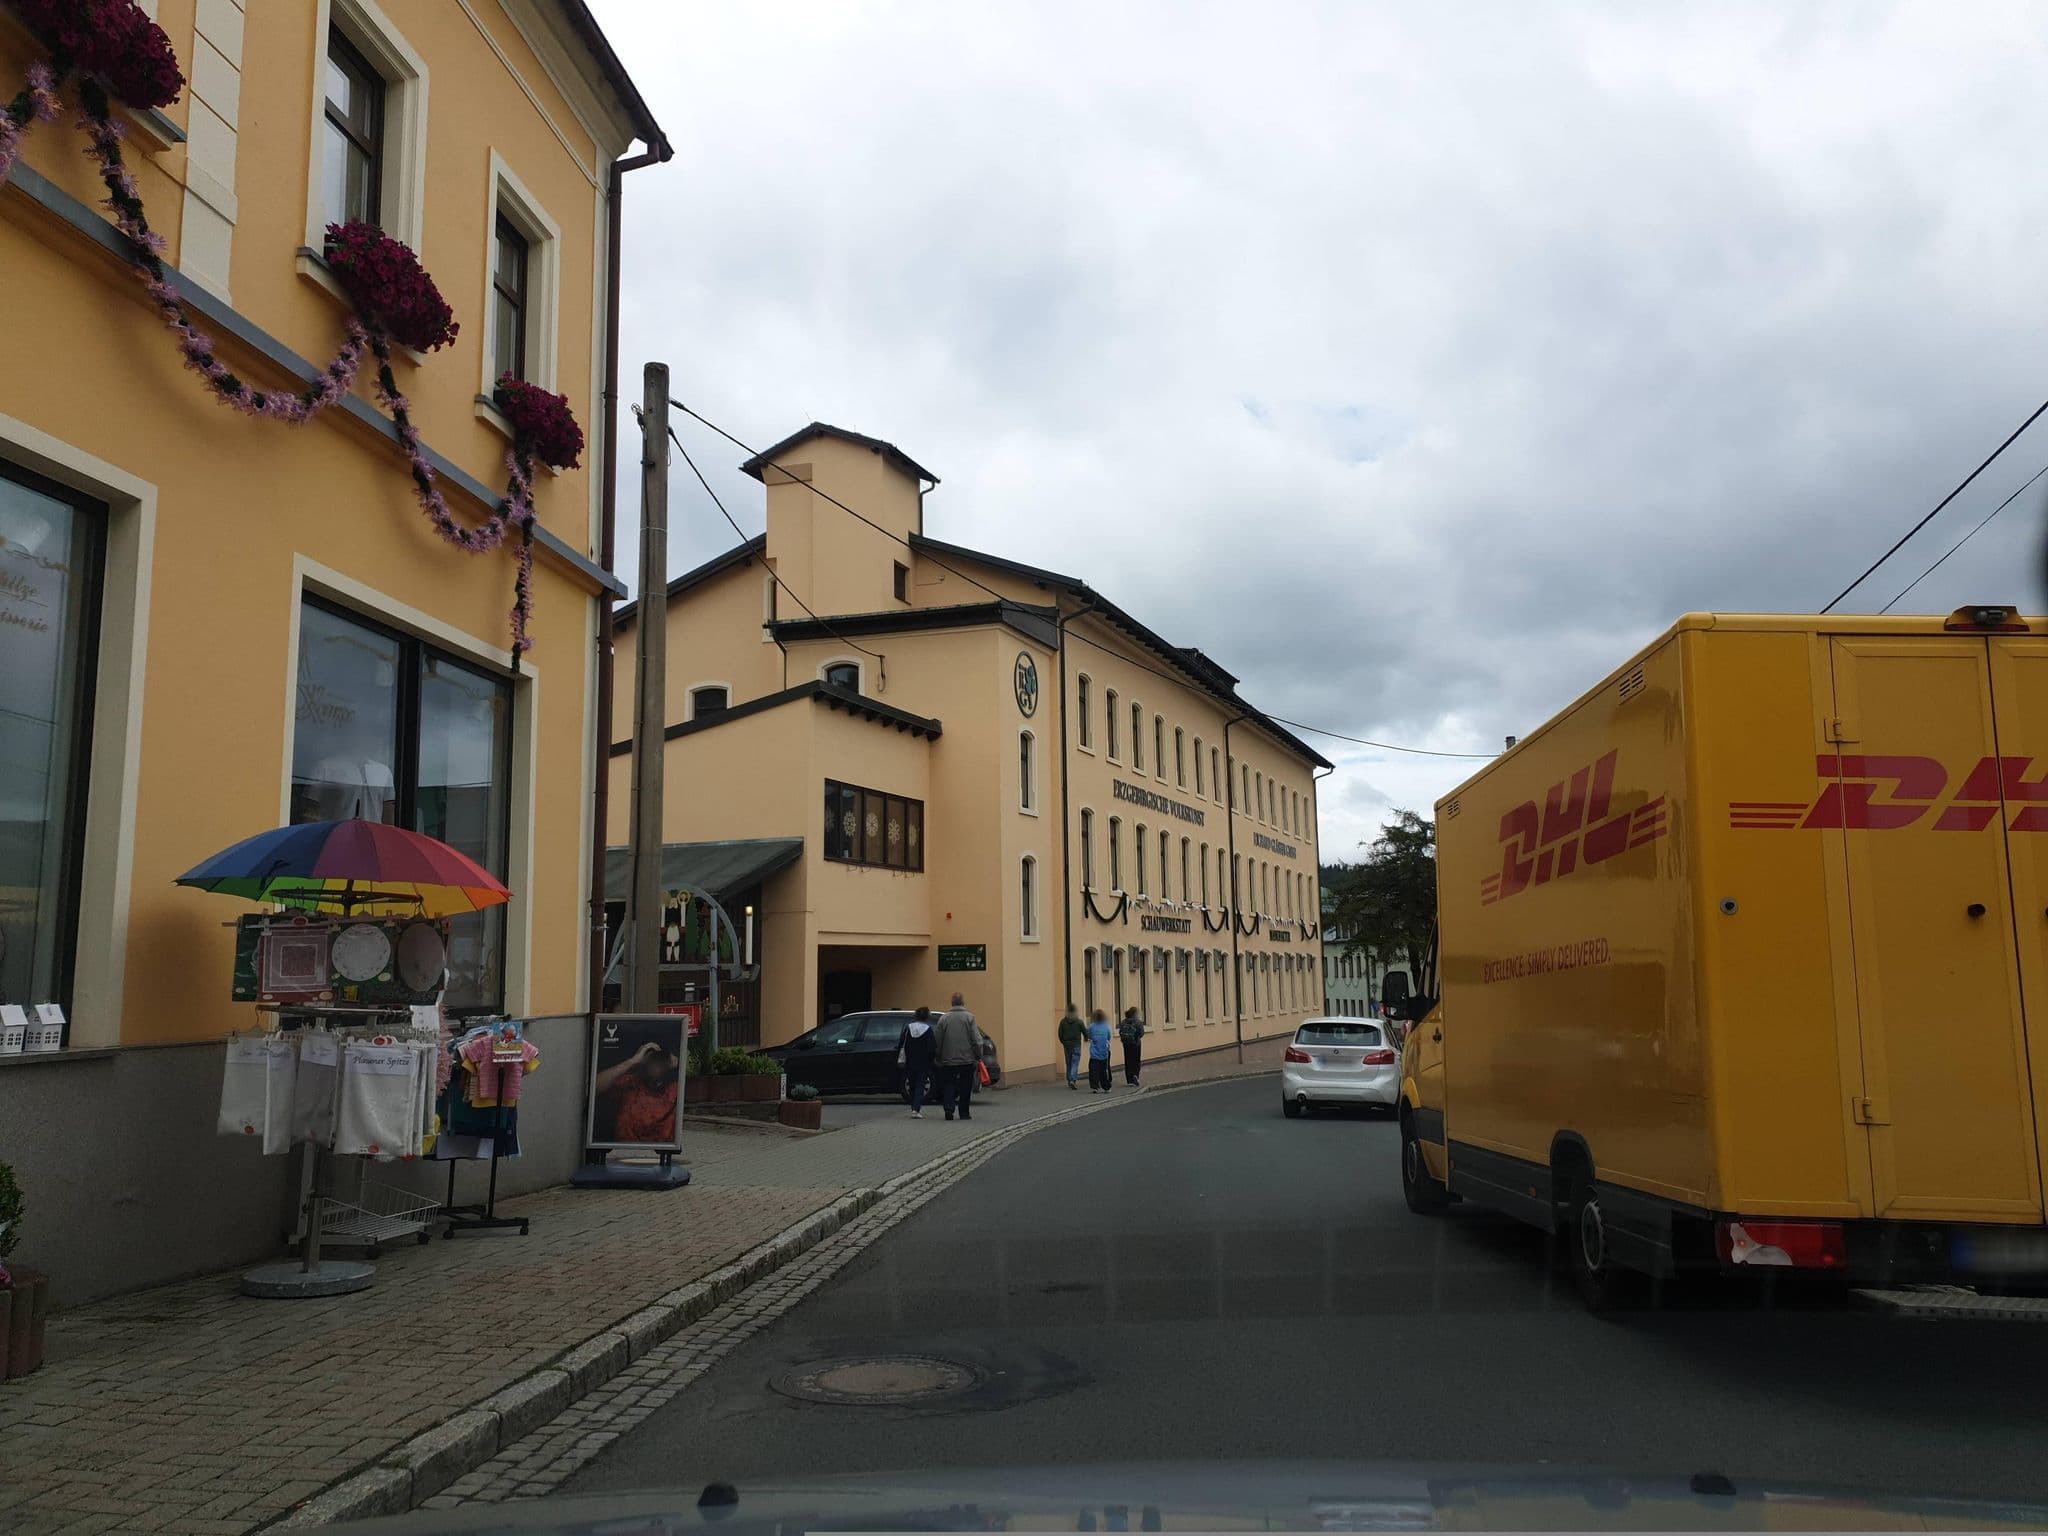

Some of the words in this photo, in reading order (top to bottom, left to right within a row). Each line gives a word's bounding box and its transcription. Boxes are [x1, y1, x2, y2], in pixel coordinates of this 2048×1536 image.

[1113, 779, 1169, 815] ERZGEBIRGISCHE
[1169, 799, 1205, 827] VOLKSKUNST
[1499, 748, 1634, 898] DHL
[1141, 915, 1192, 934] SCHAUWERKSTATT
[1484, 954, 1526, 984] EXCELLENCE.
[1528, 948, 1557, 976] SIMPLY
[1558, 937, 1611, 970] DELIVERED.
[386, 1056, 410, 1069] Spitze
